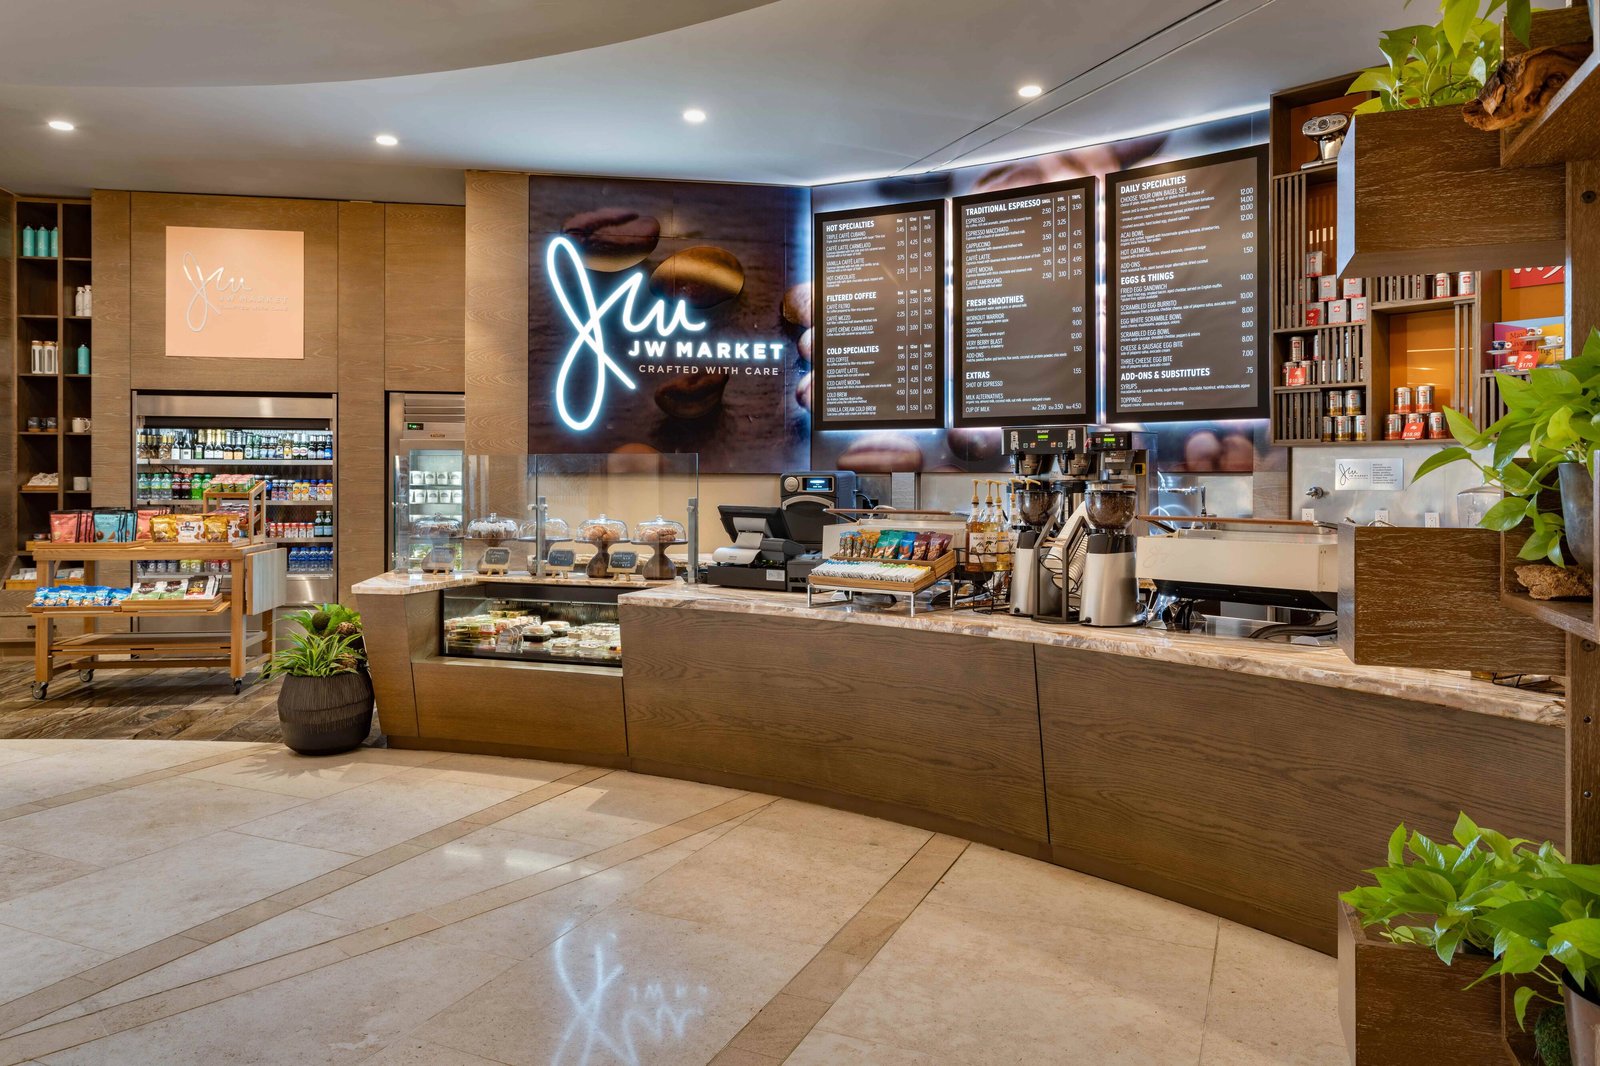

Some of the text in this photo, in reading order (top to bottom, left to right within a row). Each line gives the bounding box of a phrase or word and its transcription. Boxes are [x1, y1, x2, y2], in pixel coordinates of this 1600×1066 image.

[1120, 175, 1185, 194] DAILY SPECIALTIES
[1240, 187, 1253, 195] 12.00
[1120, 195, 1137, 203] CHOOSE
[1240, 195, 1253, 203] 14.00
[966, 198, 1040, 216] TRADITIONAL ESPRESSO
[1240, 203, 1253, 211] 10.00
[838, 220, 874, 230] SPECIALTIES
[1130, 246, 1150, 254] OATMEAL
[1120, 271, 1174, 285] EGGS & THINGS
[1143, 283, 1167, 291] SANDWICH
[826, 293, 852, 301] FILTERED
[966, 294, 1023, 307] FRESH SMOOTHIES
[1120, 303, 1146, 311] SCRAMBLED
[628, 340, 784, 360] JW MARKET
[843, 345, 879, 353] SPECIALTIES
[1120, 357, 1151, 365] THREE-CHEESE
[638, 365, 779, 376] CRAFTED WITH CARE
[1120, 371, 1152, 380] ADD-ONS
[1161, 367, 1209, 378] SUBSTITUTES
[966, 371, 989, 379] EXTRAS
